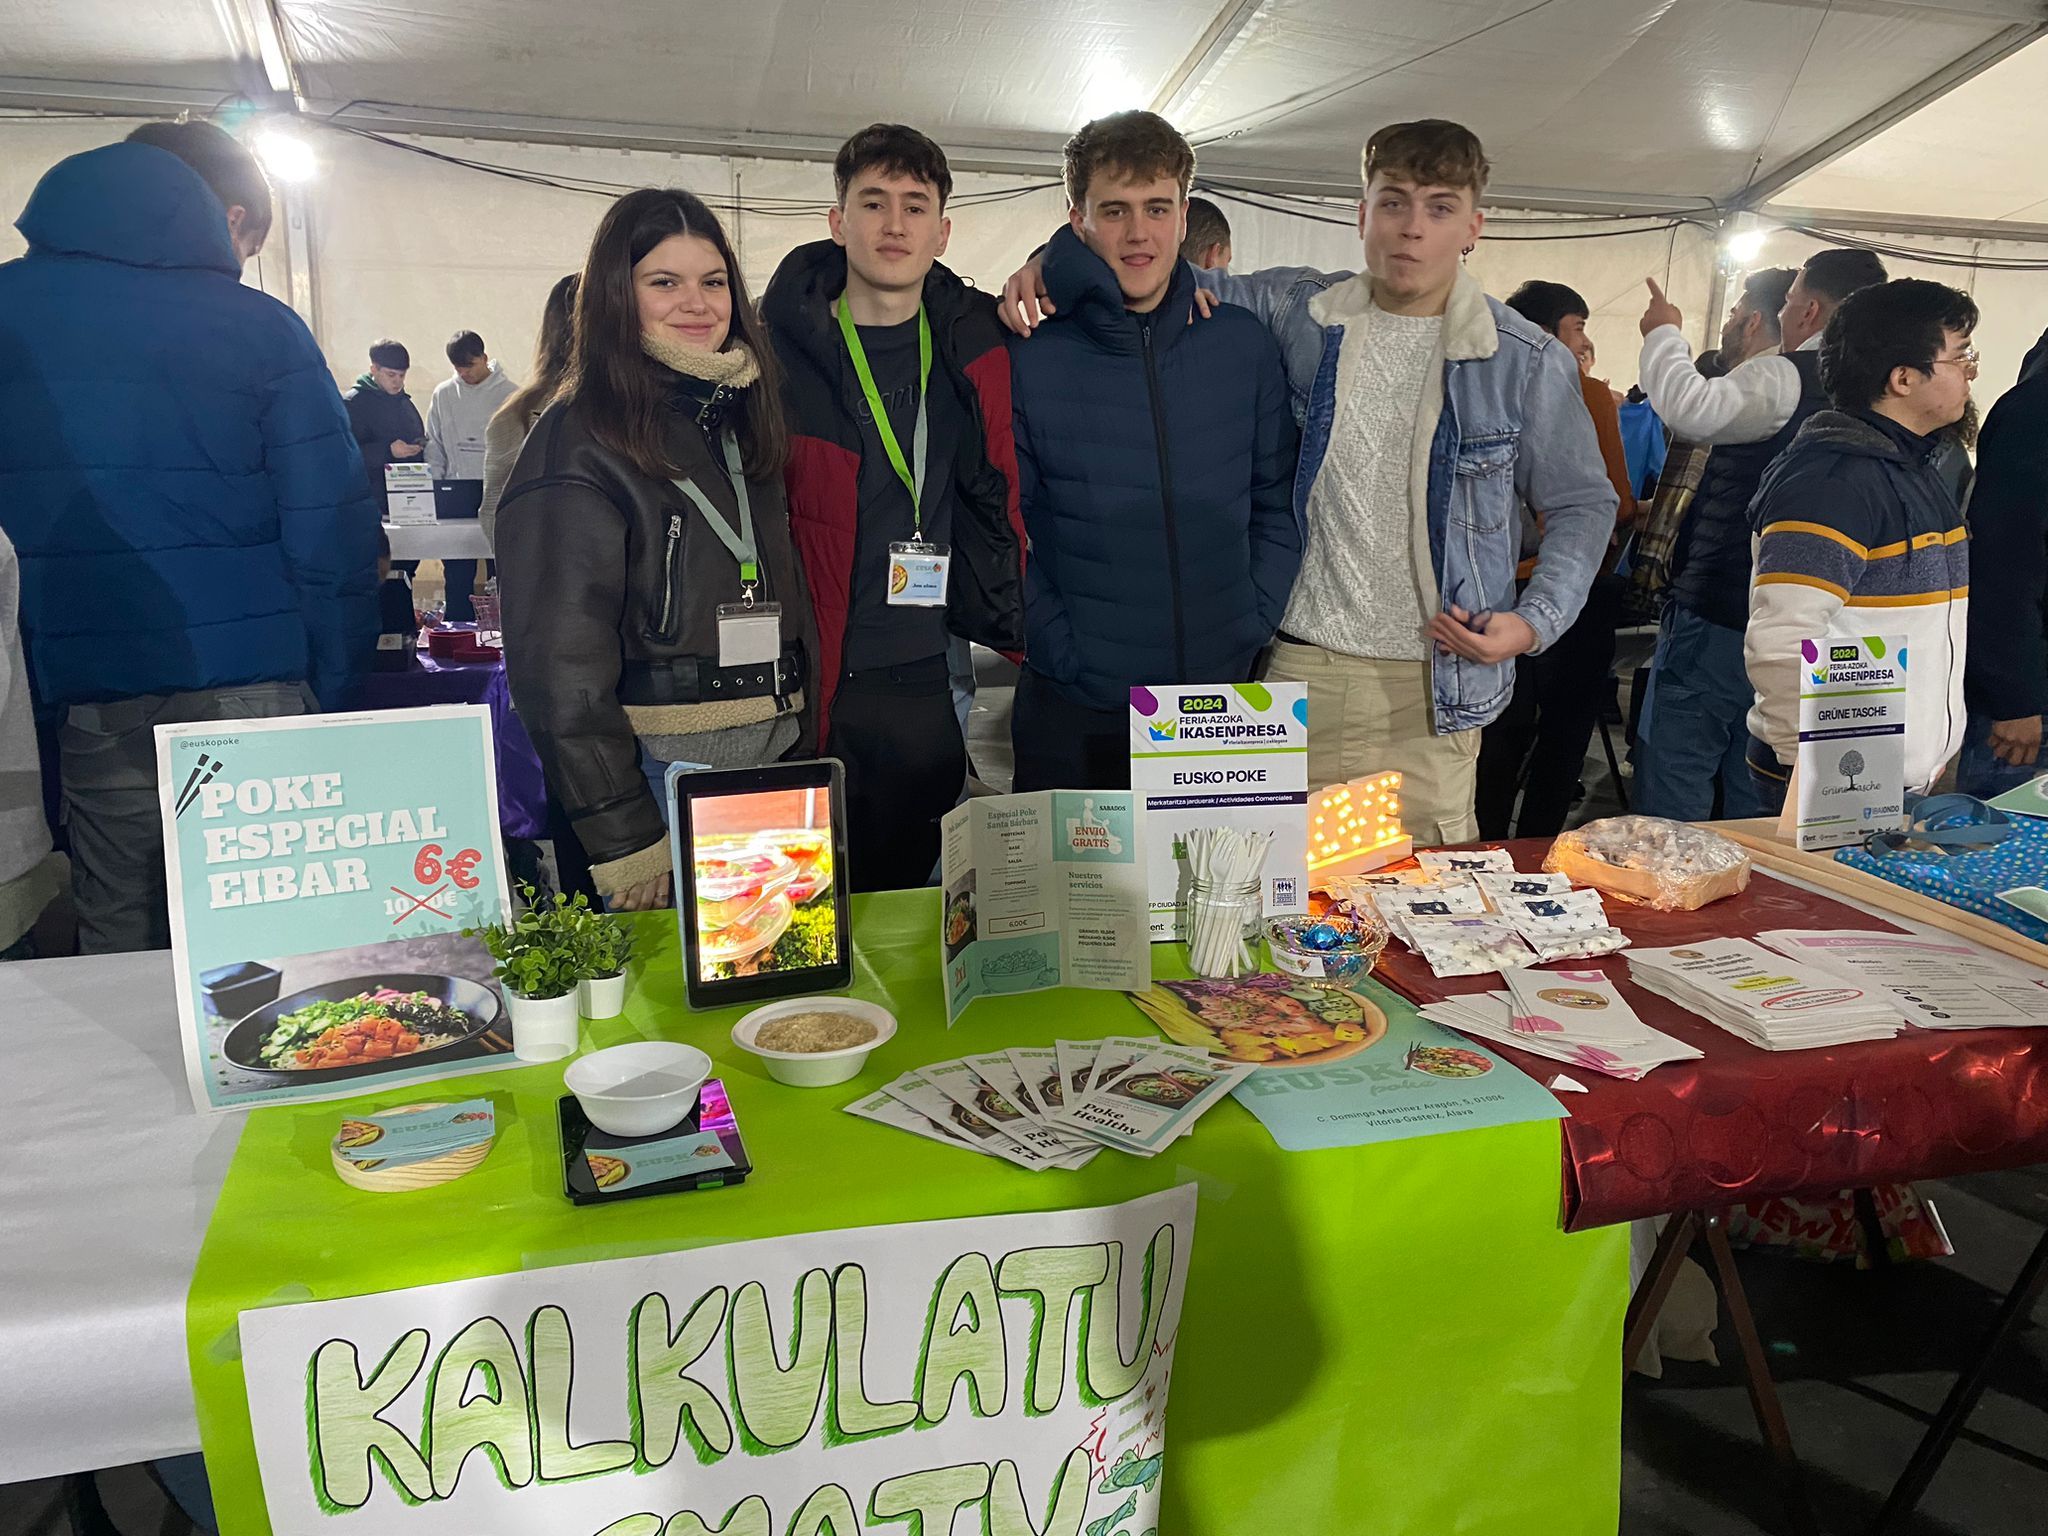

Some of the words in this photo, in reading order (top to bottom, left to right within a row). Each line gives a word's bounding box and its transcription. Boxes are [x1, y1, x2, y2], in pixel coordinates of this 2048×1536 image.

[1832, 648, 1857, 659] 2024
[1829, 669, 1894, 683] IKASENPRESA
[1183, 698, 1223, 711] 2024
[1818, 707, 1850, 722] GRÜNE
[1852, 706, 1887, 719] TASCHE
[1180, 724, 1288, 739] IKASENPRESA
[180, 737, 240, 750] @euskopoke
[1173, 772, 1224, 785] EUSKO
[1226, 769, 1267, 783] POKE
[201, 772, 343, 819] POKE
[1148, 798, 1186, 807] Merkataritza
[1219, 796, 1254, 804] Actividades
[1255, 794, 1292, 802] Comerciales
[988, 809, 1018, 820] Especial
[1020, 808, 1037, 816] Poke
[987, 821, 1008, 829] Santa
[1075, 827, 1106, 836] ENVIO
[203, 806, 447, 864] ESPECIAL
[1072, 838, 1110, 848] GRATIS
[413, 843, 483, 889] 6€
[1068, 872, 1103, 880] Nuestros
[208, 857, 370, 909] EIBAR
[1069, 881, 1103, 889] servicios
[1082, 1103, 1124, 1120] Poke
[1330, 1111, 1375, 1121] Domingo
[1073, 1110, 1142, 1135] Healthy
[307, 1224, 1175, 1515] KALKULATU
